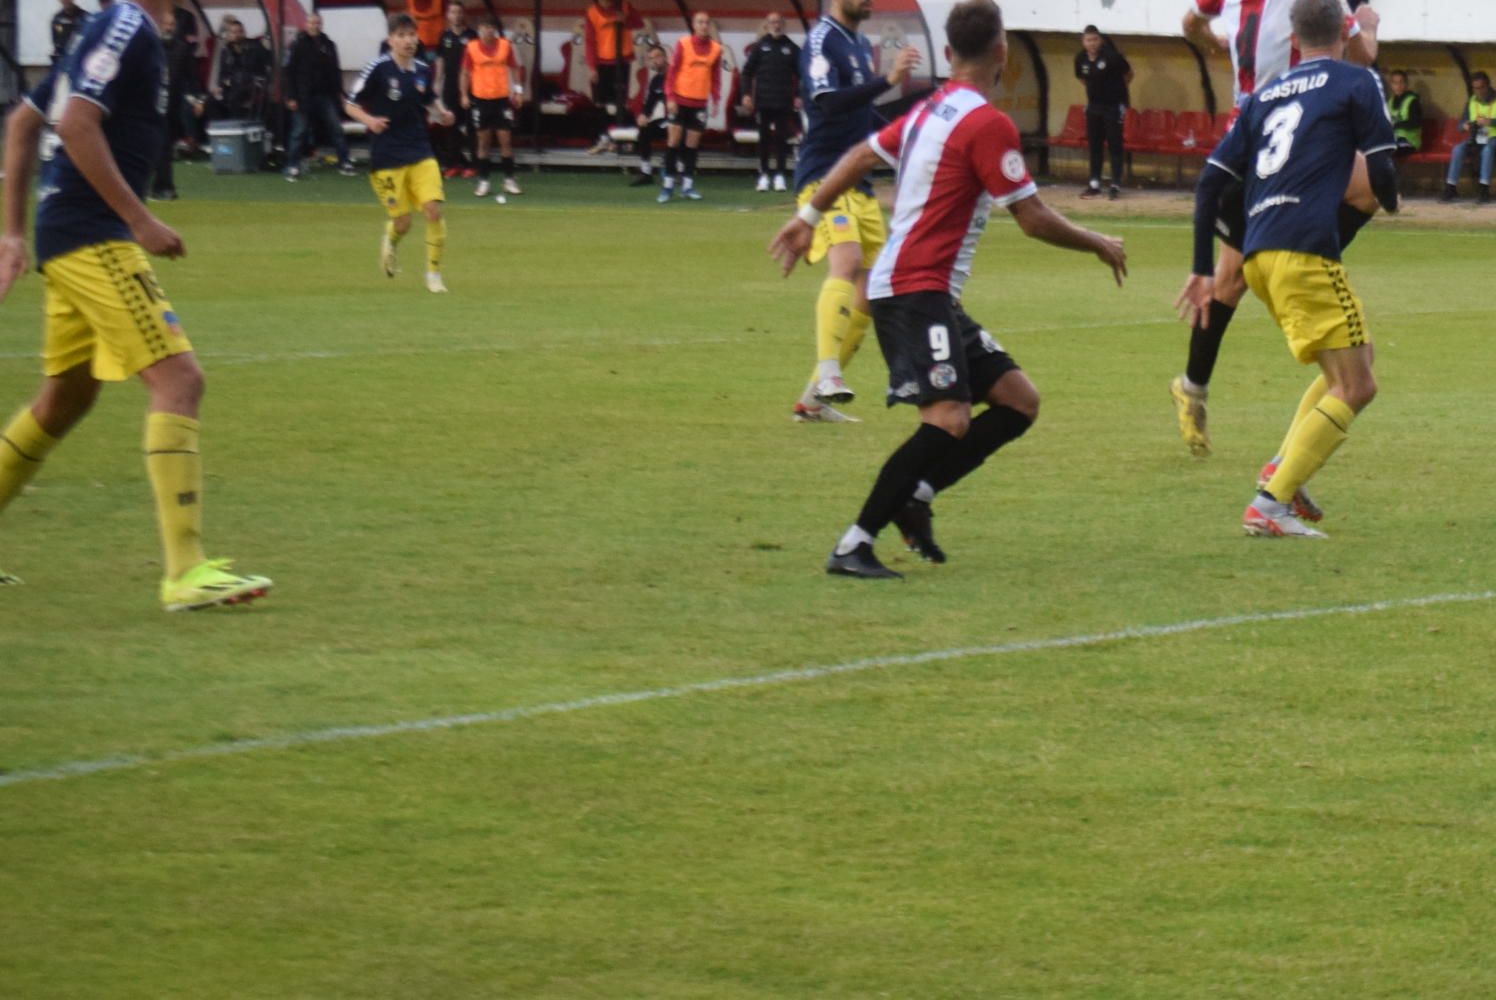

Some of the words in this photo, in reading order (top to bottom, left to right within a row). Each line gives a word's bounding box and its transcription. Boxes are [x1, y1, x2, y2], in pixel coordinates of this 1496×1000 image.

[1259, 71, 1330, 103] CASTILLO
[1255, 100, 1304, 180] 3
[928, 324, 951, 361] 9
